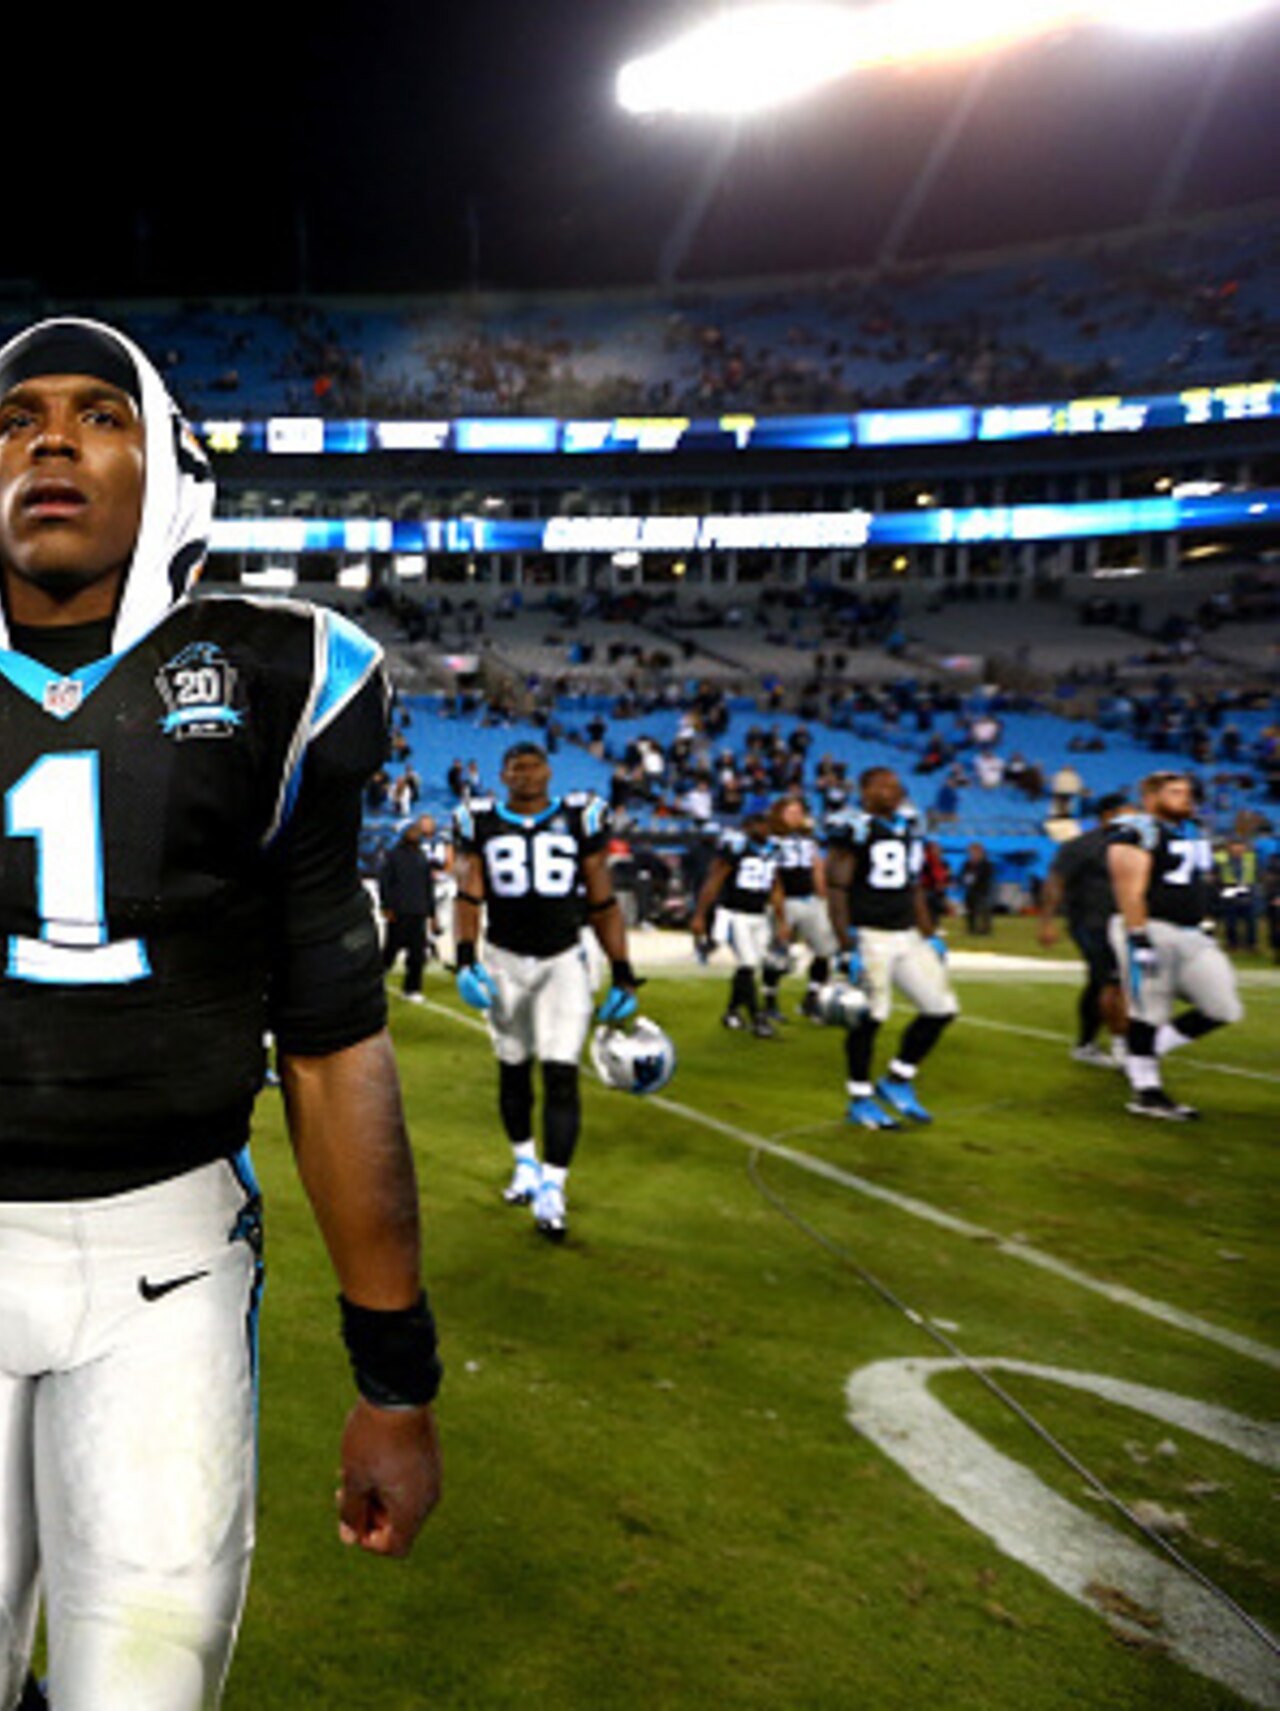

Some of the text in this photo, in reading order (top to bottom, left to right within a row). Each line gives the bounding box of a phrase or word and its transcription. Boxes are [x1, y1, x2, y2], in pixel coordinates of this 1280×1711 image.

[173, 667, 220, 705] 20
[4, 749, 152, 984] 1
[484, 831, 578, 897] 86
